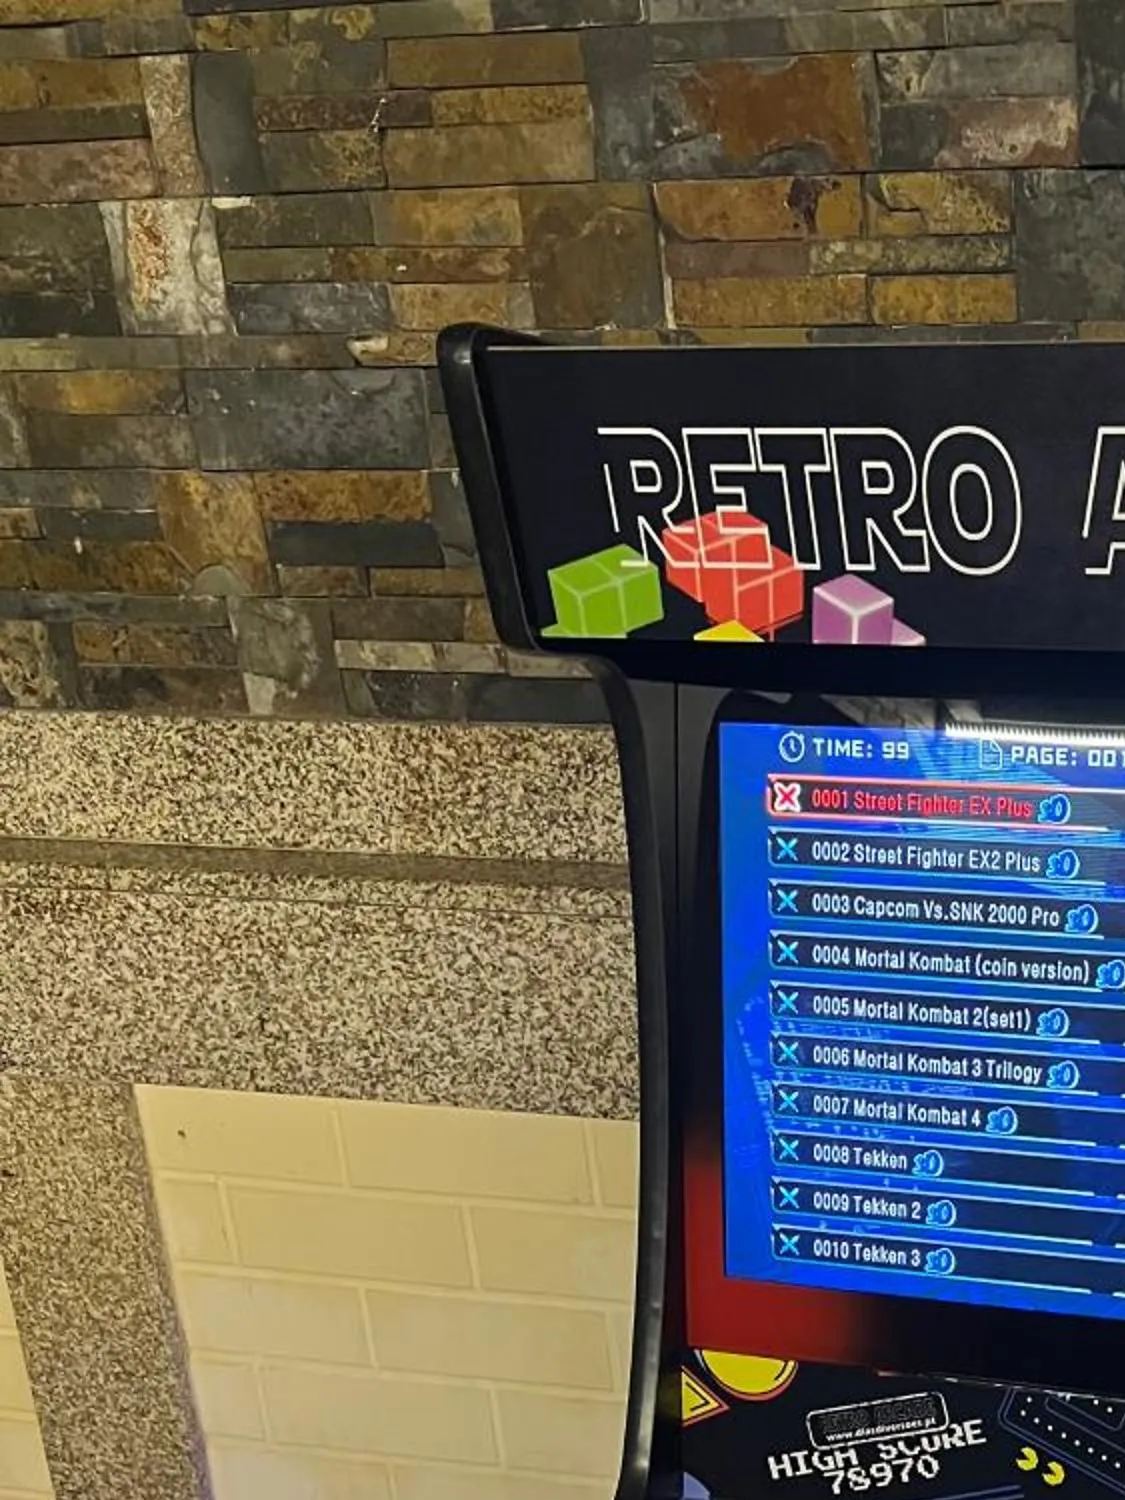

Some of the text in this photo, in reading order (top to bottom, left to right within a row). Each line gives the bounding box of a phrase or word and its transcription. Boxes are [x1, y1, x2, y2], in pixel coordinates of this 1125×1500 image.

[597, 425, 1023, 576] RETRO
[813, 737, 910, 761] TIME: 99
[1010, 745, 1077, 768] PAGE:
[812, 788, 849, 810] 0001
[853, 790, 903, 813] Street
[906, 794, 964, 818] Fighter
[969, 796, 991, 816] EX
[997, 798, 1033, 819] Plus
[812, 841, 850, 863] 0002
[853, 843, 903, 866] Street
[906, 847, 965, 872] Fighter
[968, 850, 1001, 870] EX2
[1004, 851, 1041, 873] Plus
[812, 893, 851, 914] 0003
[853, 895, 919, 920] Capcom
[987, 904, 1027, 925] 2000
[1031, 906, 1060, 928] Pro
[812, 943, 851, 965] 0004
[854, 946, 905, 969] Mortal
[910, 951, 972, 976] Kombat
[975, 956, 1017, 981] (coin
[1020, 960, 1090, 985] version)
[812, 998, 850, 1017] 0005
[853, 999, 904, 1021] Mortal
[906, 1003, 971, 1027] Kombat
[972, 1007, 1032, 1032] 2(set1)
[812, 1046, 850, 1067] 0006
[853, 1049, 904, 1072] Mortal
[906, 1053, 971, 1078] Kombat
[971, 1058, 983, 1078] 3
[986, 1059, 1043, 1084] Trilogy
[812, 1096, 850, 1116] 0007
[853, 1098, 904, 1121] Mortal
[906, 1102, 970, 1127] Kombat
[970, 1107, 982, 1128] 4
[812, 1144, 851, 1165] 0008
[853, 1147, 908, 1171] Tekken
[812, 1192, 850, 1212] 0009
[853, 1195, 908, 1218] Tekken
[910, 1200, 922, 1220] 2
[812, 1239, 850, 1259] 0010
[853, 1242, 908, 1265] Tekken
[910, 1248, 922, 1267] 3
[767, 1446, 860, 1481] HIGH
[822, 1453, 941, 1496] 78970
